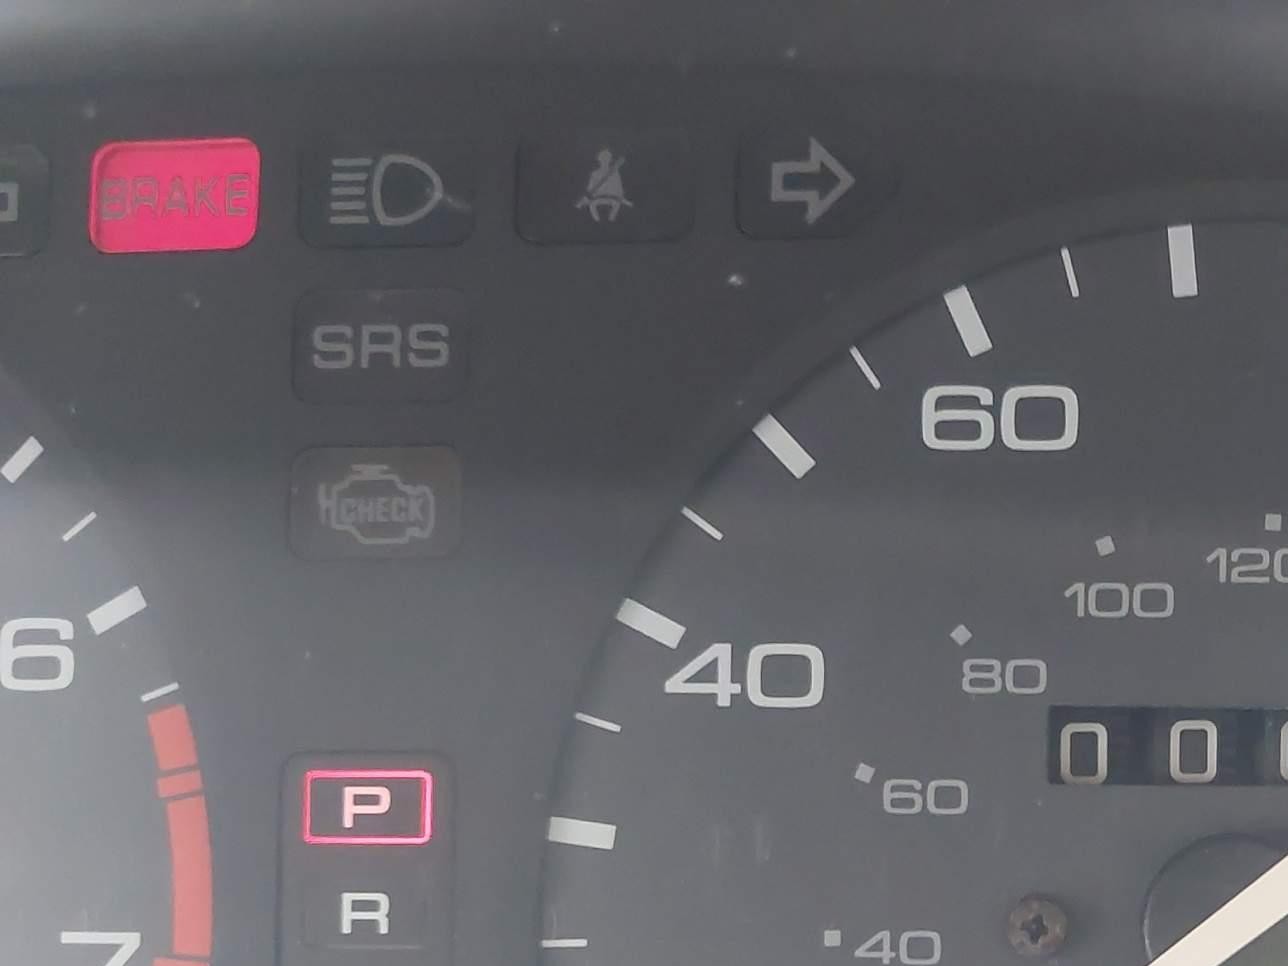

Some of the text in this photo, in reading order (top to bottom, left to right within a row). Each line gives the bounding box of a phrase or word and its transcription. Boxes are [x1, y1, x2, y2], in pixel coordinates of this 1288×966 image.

[101, 172, 251, 220] BRAKE
[313, 324, 449, 369] SRS
[922, 385, 1078, 450] 60
[339, 497, 424, 523] CHECK
[1064, 583, 1174, 617] 100
[0, 618, 74, 691] 6
[663, 641, 825, 710] 40
[962, 659, 1047, 694] 80
[343, 787, 390, 827] P
[883, 779, 968, 814] 60
[342, 893, 389, 934] R
[854, 931, 941, 965] 40
